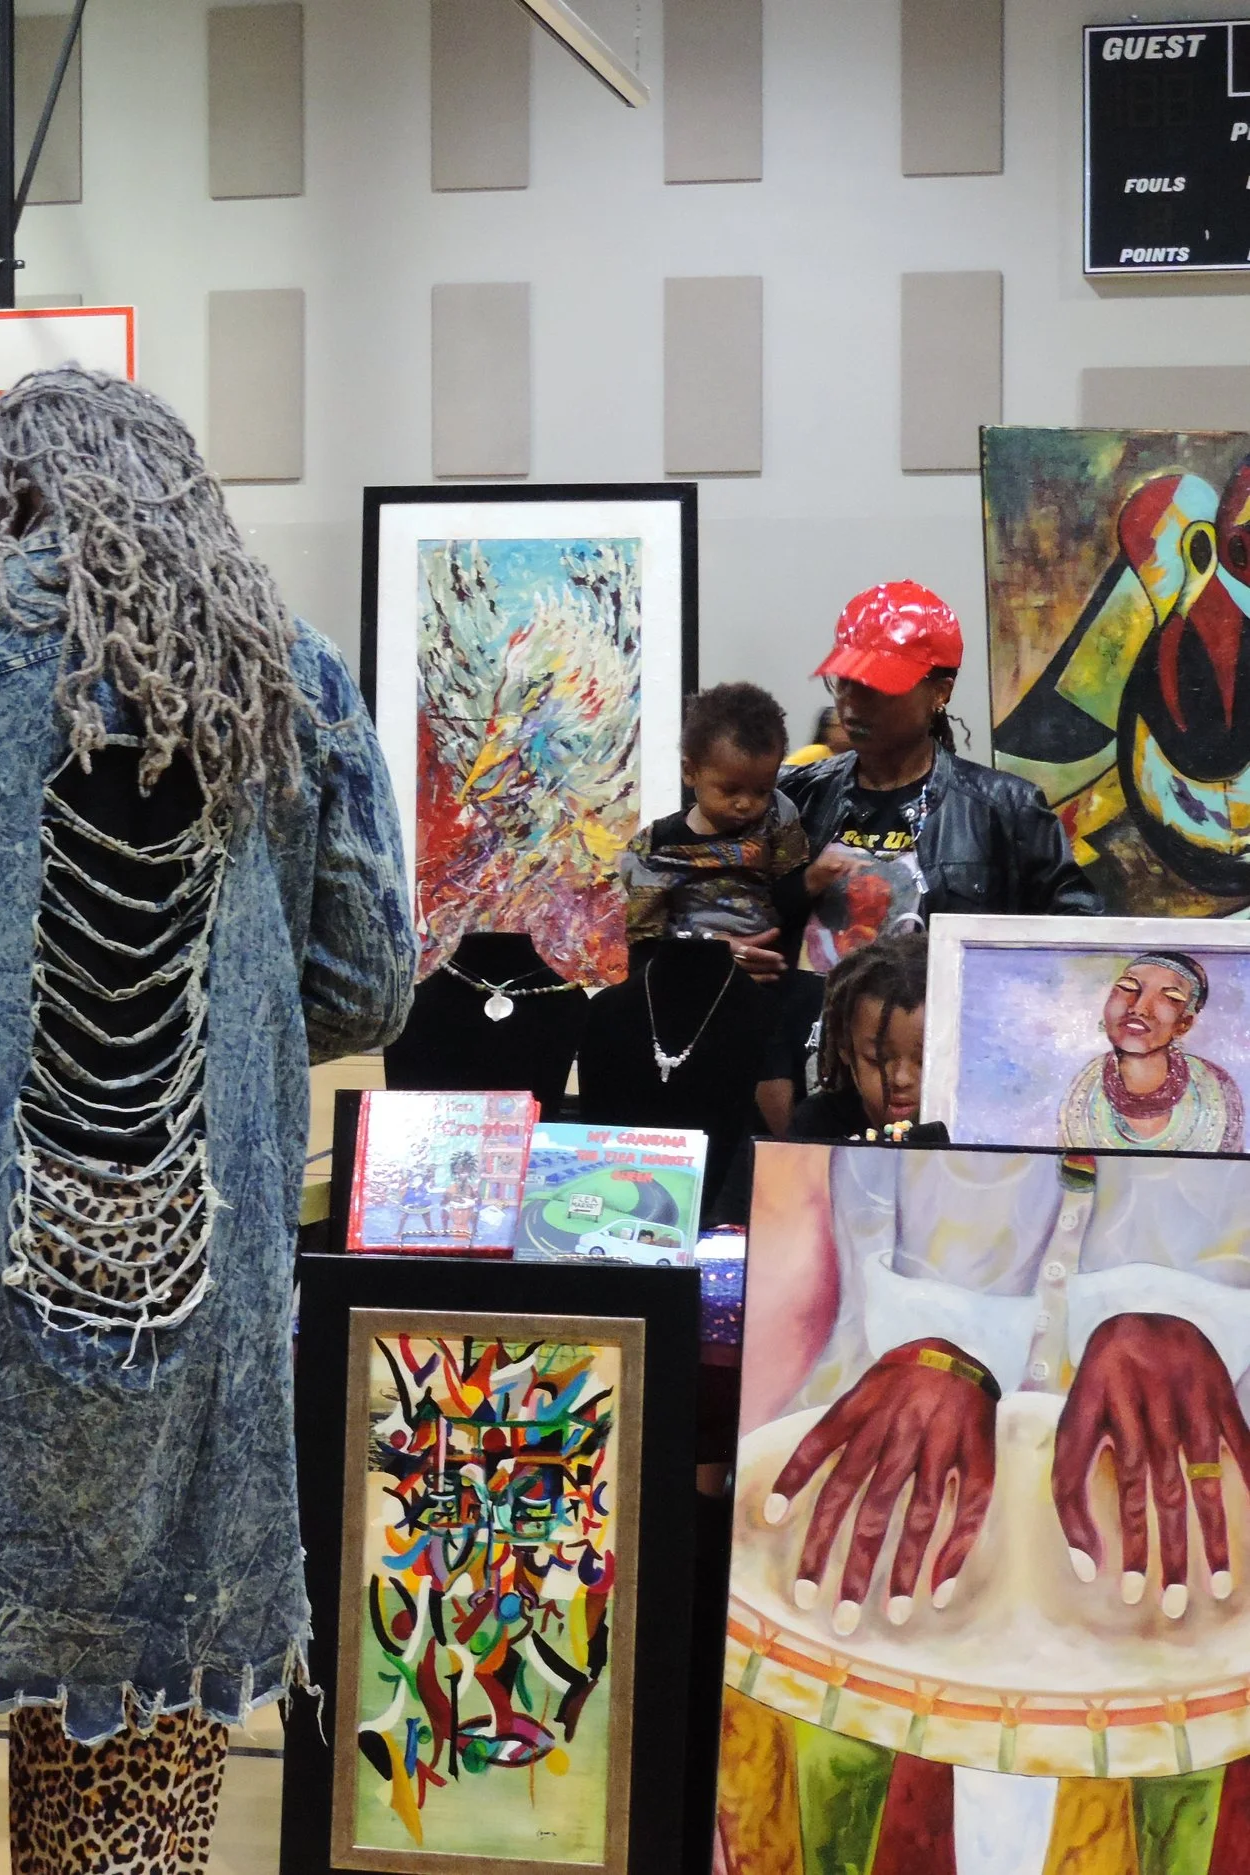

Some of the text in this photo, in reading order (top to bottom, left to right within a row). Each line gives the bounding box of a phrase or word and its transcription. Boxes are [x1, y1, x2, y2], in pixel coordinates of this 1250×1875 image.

[1102, 34, 1206, 61] GUEST
[1124, 176, 1186, 193] FOULS
[1119, 247, 1190, 263] POINTS
[840, 830, 880, 848] For
[616, 1132, 687, 1148] GRANDMA
[605, 1150, 636, 1164] FLEA
[641, 1153, 695, 1168] MARKET
